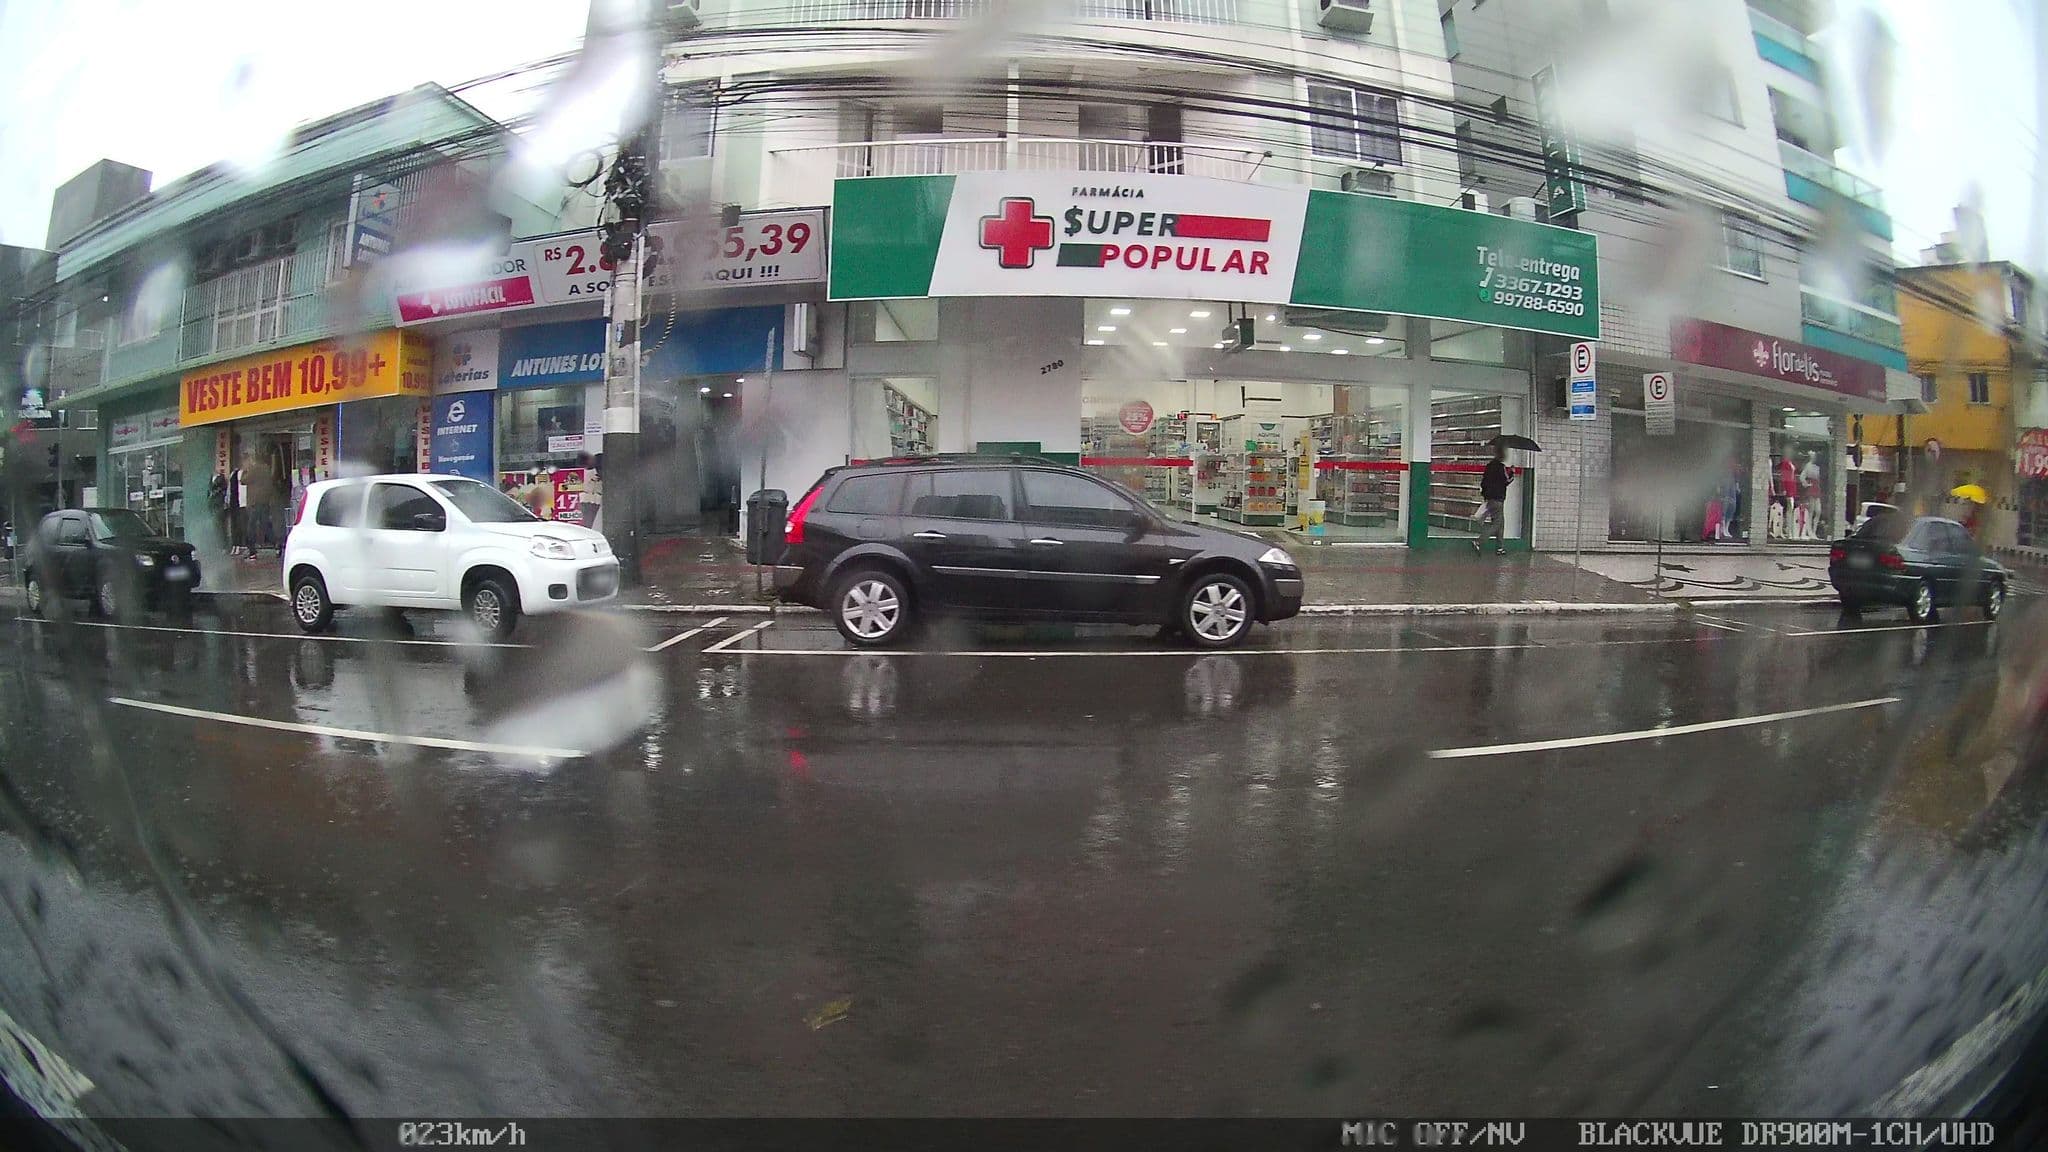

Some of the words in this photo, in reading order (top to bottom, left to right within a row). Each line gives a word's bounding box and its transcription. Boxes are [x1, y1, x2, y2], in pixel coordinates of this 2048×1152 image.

[1072, 186, 1144, 198] FARMÁCIA
[1100, 243, 1270, 275] POPULAR
[569, 284, 581, 295] A
[1494, 273, 1583, 300] 3367-1293
[1493, 291, 1584, 316] 99788-6590
[511, 355, 578, 378] ANTUNES
[1040, 359, 1064, 375] 2780
[1578, 350, 1585, 368] E
[186, 371, 241, 414] VESTE
[246, 361, 292, 403] BEM
[1655, 380, 1662, 394] E
[437, 424, 478, 436] INTERNET
